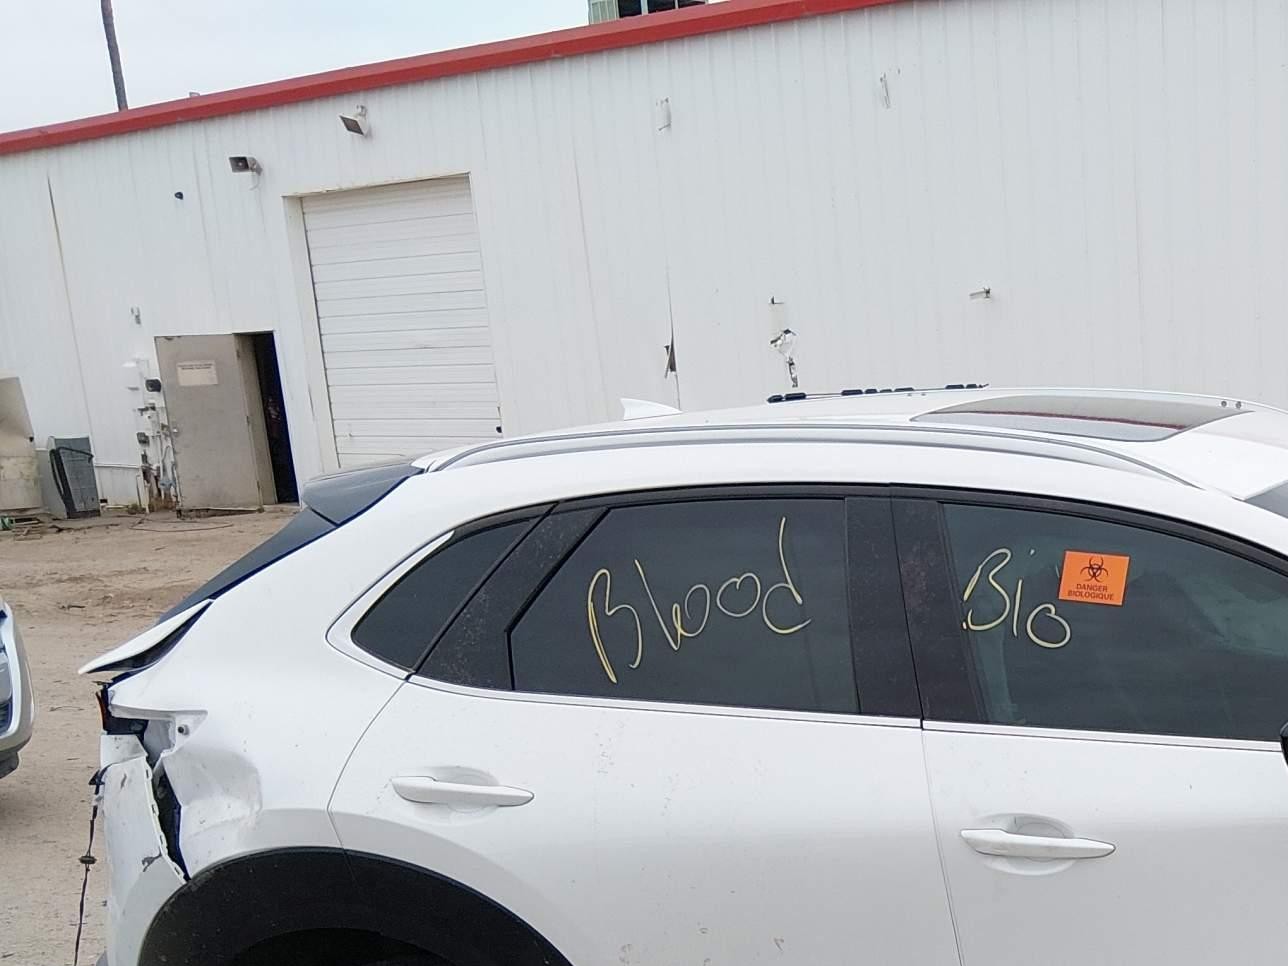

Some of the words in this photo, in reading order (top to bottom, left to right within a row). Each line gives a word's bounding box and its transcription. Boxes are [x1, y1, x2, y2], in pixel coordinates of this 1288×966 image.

[1076, 583, 1108, 592] DANGER
[587, 516, 812, 684] Blood
[1067, 590, 1115, 601] BIOLOGIQUE
